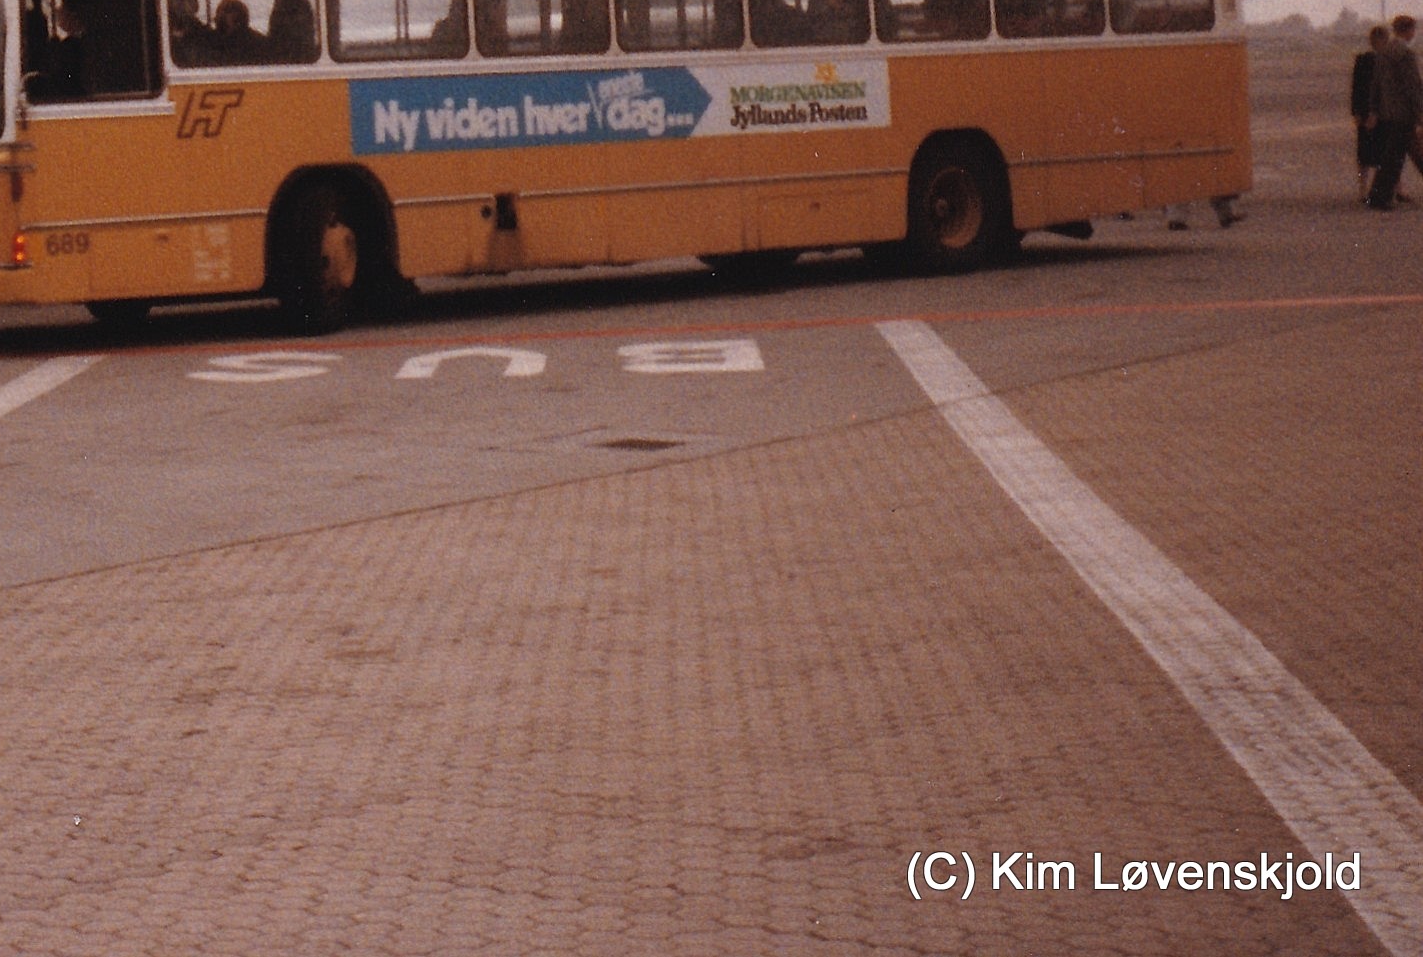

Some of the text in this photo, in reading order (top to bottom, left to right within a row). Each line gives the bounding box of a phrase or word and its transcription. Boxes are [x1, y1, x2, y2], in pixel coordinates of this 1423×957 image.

[730, 81, 867, 105] MORGENAVISEN
[373, 99, 420, 151] Ny
[425, 97, 520, 141] viden
[523, 95, 591, 137] hver
[46, 232, 90, 257] 689
